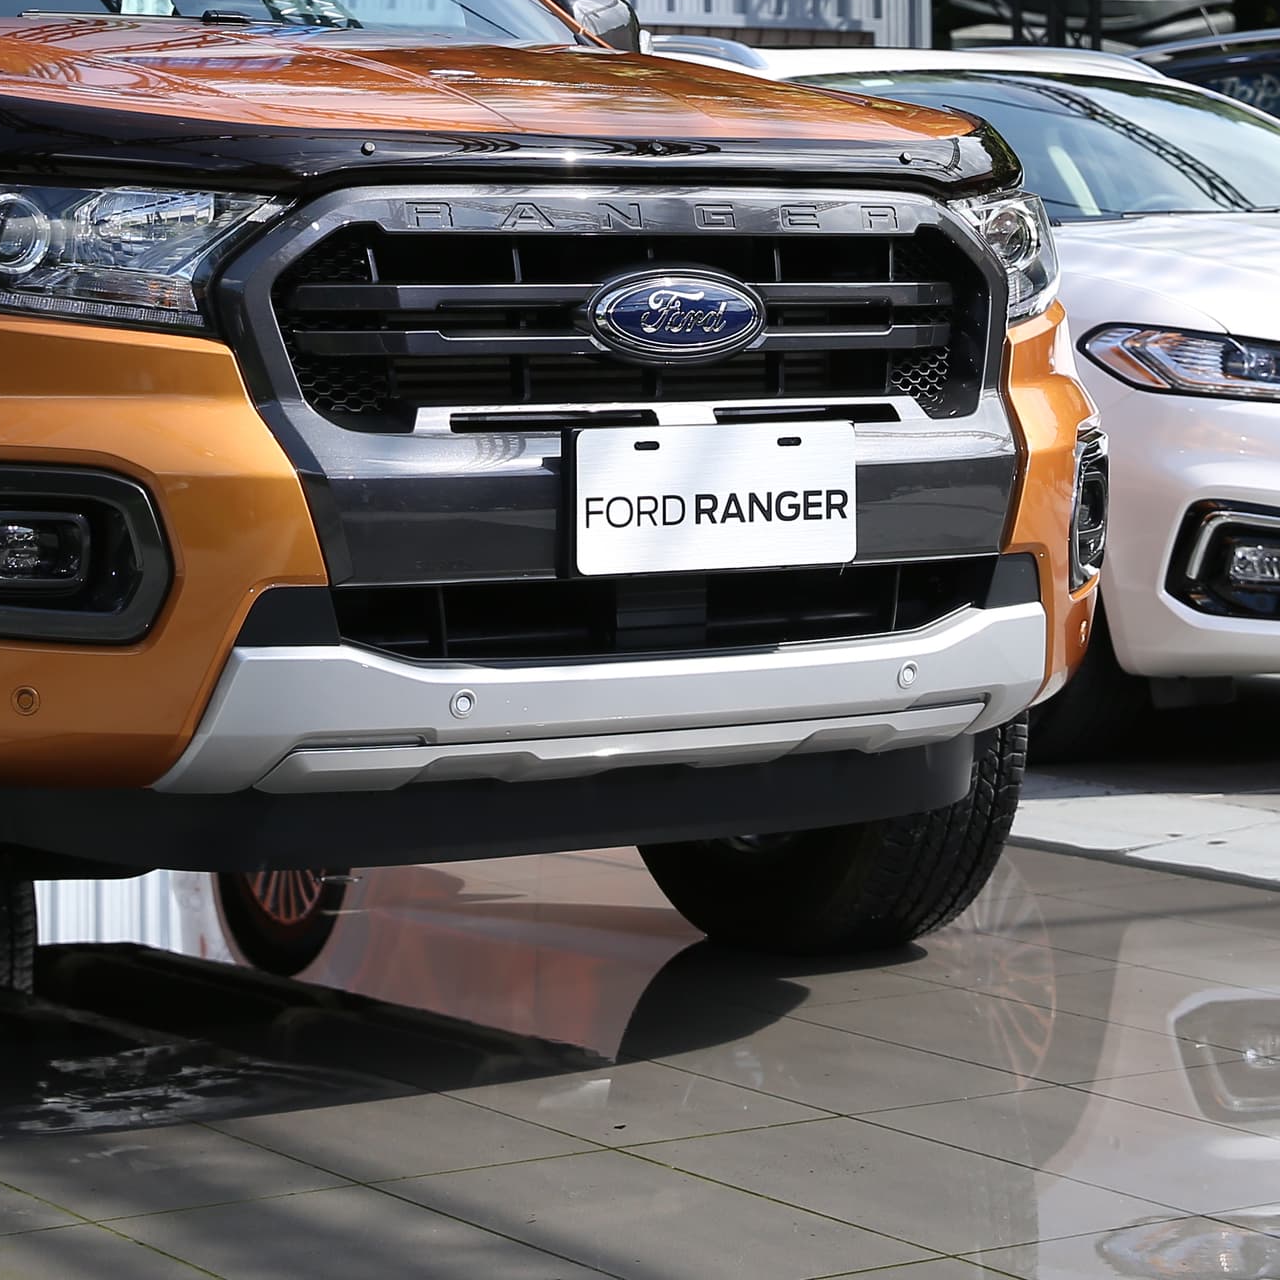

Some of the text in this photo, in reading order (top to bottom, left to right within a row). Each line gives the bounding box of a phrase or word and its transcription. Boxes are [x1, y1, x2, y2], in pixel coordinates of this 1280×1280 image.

[404, 202, 899, 231] RANGER
[640, 288, 729, 336] Ford
[584, 488, 849, 529] FORD RANGER
